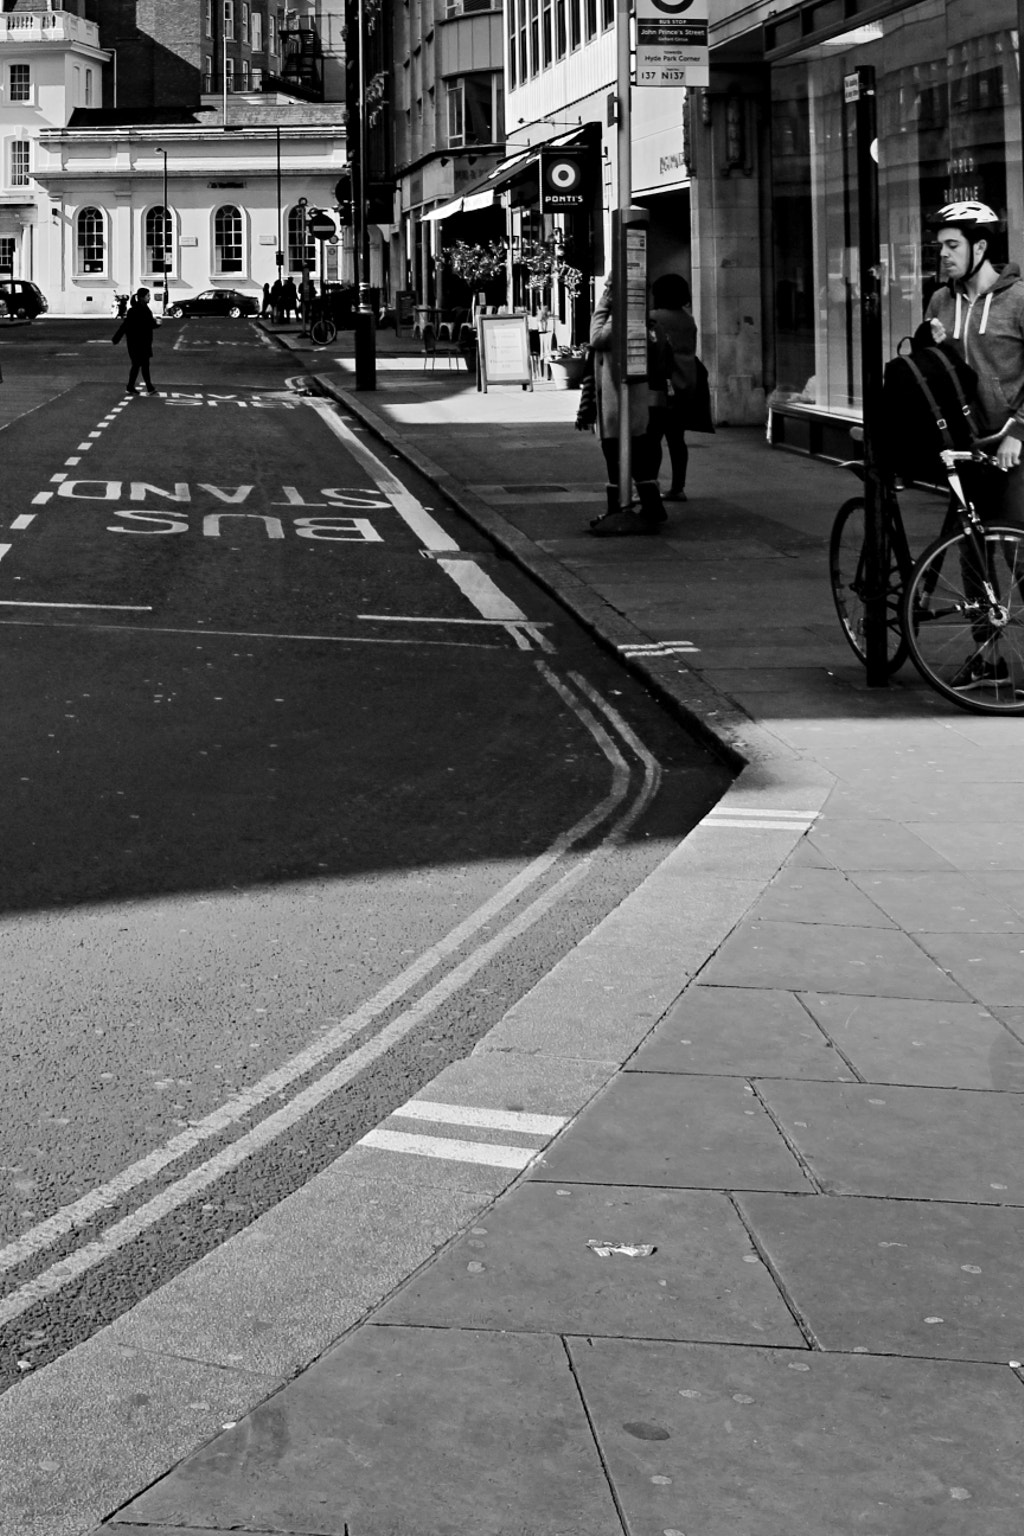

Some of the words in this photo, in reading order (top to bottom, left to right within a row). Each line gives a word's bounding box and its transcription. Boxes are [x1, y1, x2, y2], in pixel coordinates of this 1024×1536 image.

[641, 72, 656, 80] 137
[661, 72, 685, 80] N137
[57, 480, 393, 509] STAND
[106, 510, 385, 543] BUS
